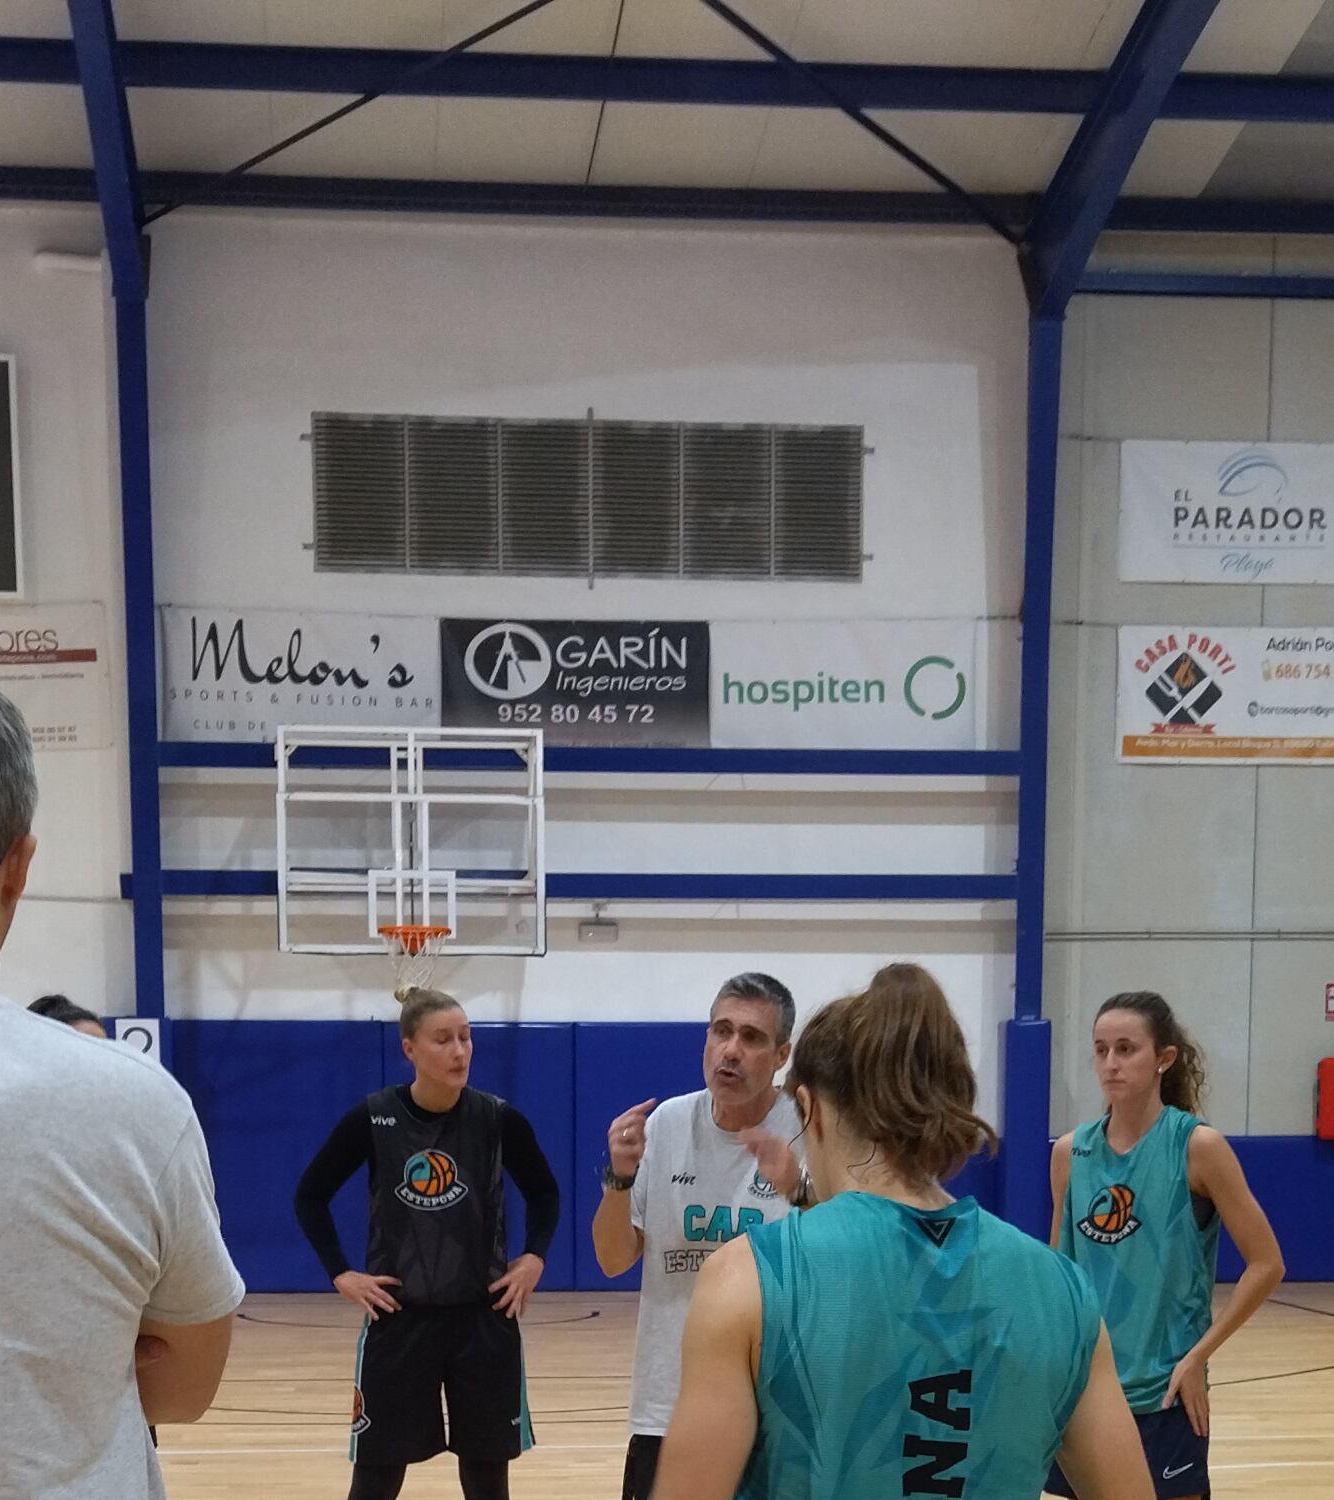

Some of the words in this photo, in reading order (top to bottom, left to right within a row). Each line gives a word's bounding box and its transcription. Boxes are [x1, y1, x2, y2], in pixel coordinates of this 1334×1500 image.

[1174, 489, 1193, 502] EL
[1173, 506, 1327, 530] PARADOR
[1172, 533, 1326, 543] RESTAURANTE
[190, 615, 415, 690] Melon's
[555, 626, 688, 670] GARÍN
[1134, 633, 1180, 675] CASA
[1187, 632, 1238, 677] PORTI
[1274, 662, 1302, 679] 686
[555, 670, 687, 697] Ingenieros
[721, 671, 886, 712] hospiten
[169, 688, 253, 703] SPORTS
[269, 692, 279, 704] &
[295, 693, 378, 707] FUSION
[395, 696, 434, 709] BAR
[497, 702, 543, 724] 952
[550, 703, 580, 724] 80
[587, 703, 618, 724] 45
[625, 704, 655, 724] 72
[193, 719, 237, 731] CLUB
[247, 719, 267, 731] DE
[370, 1115, 397, 1127] vive
[671, 1172, 697, 1186] vive
[400, 1185, 464, 1207] ESTEPONA
